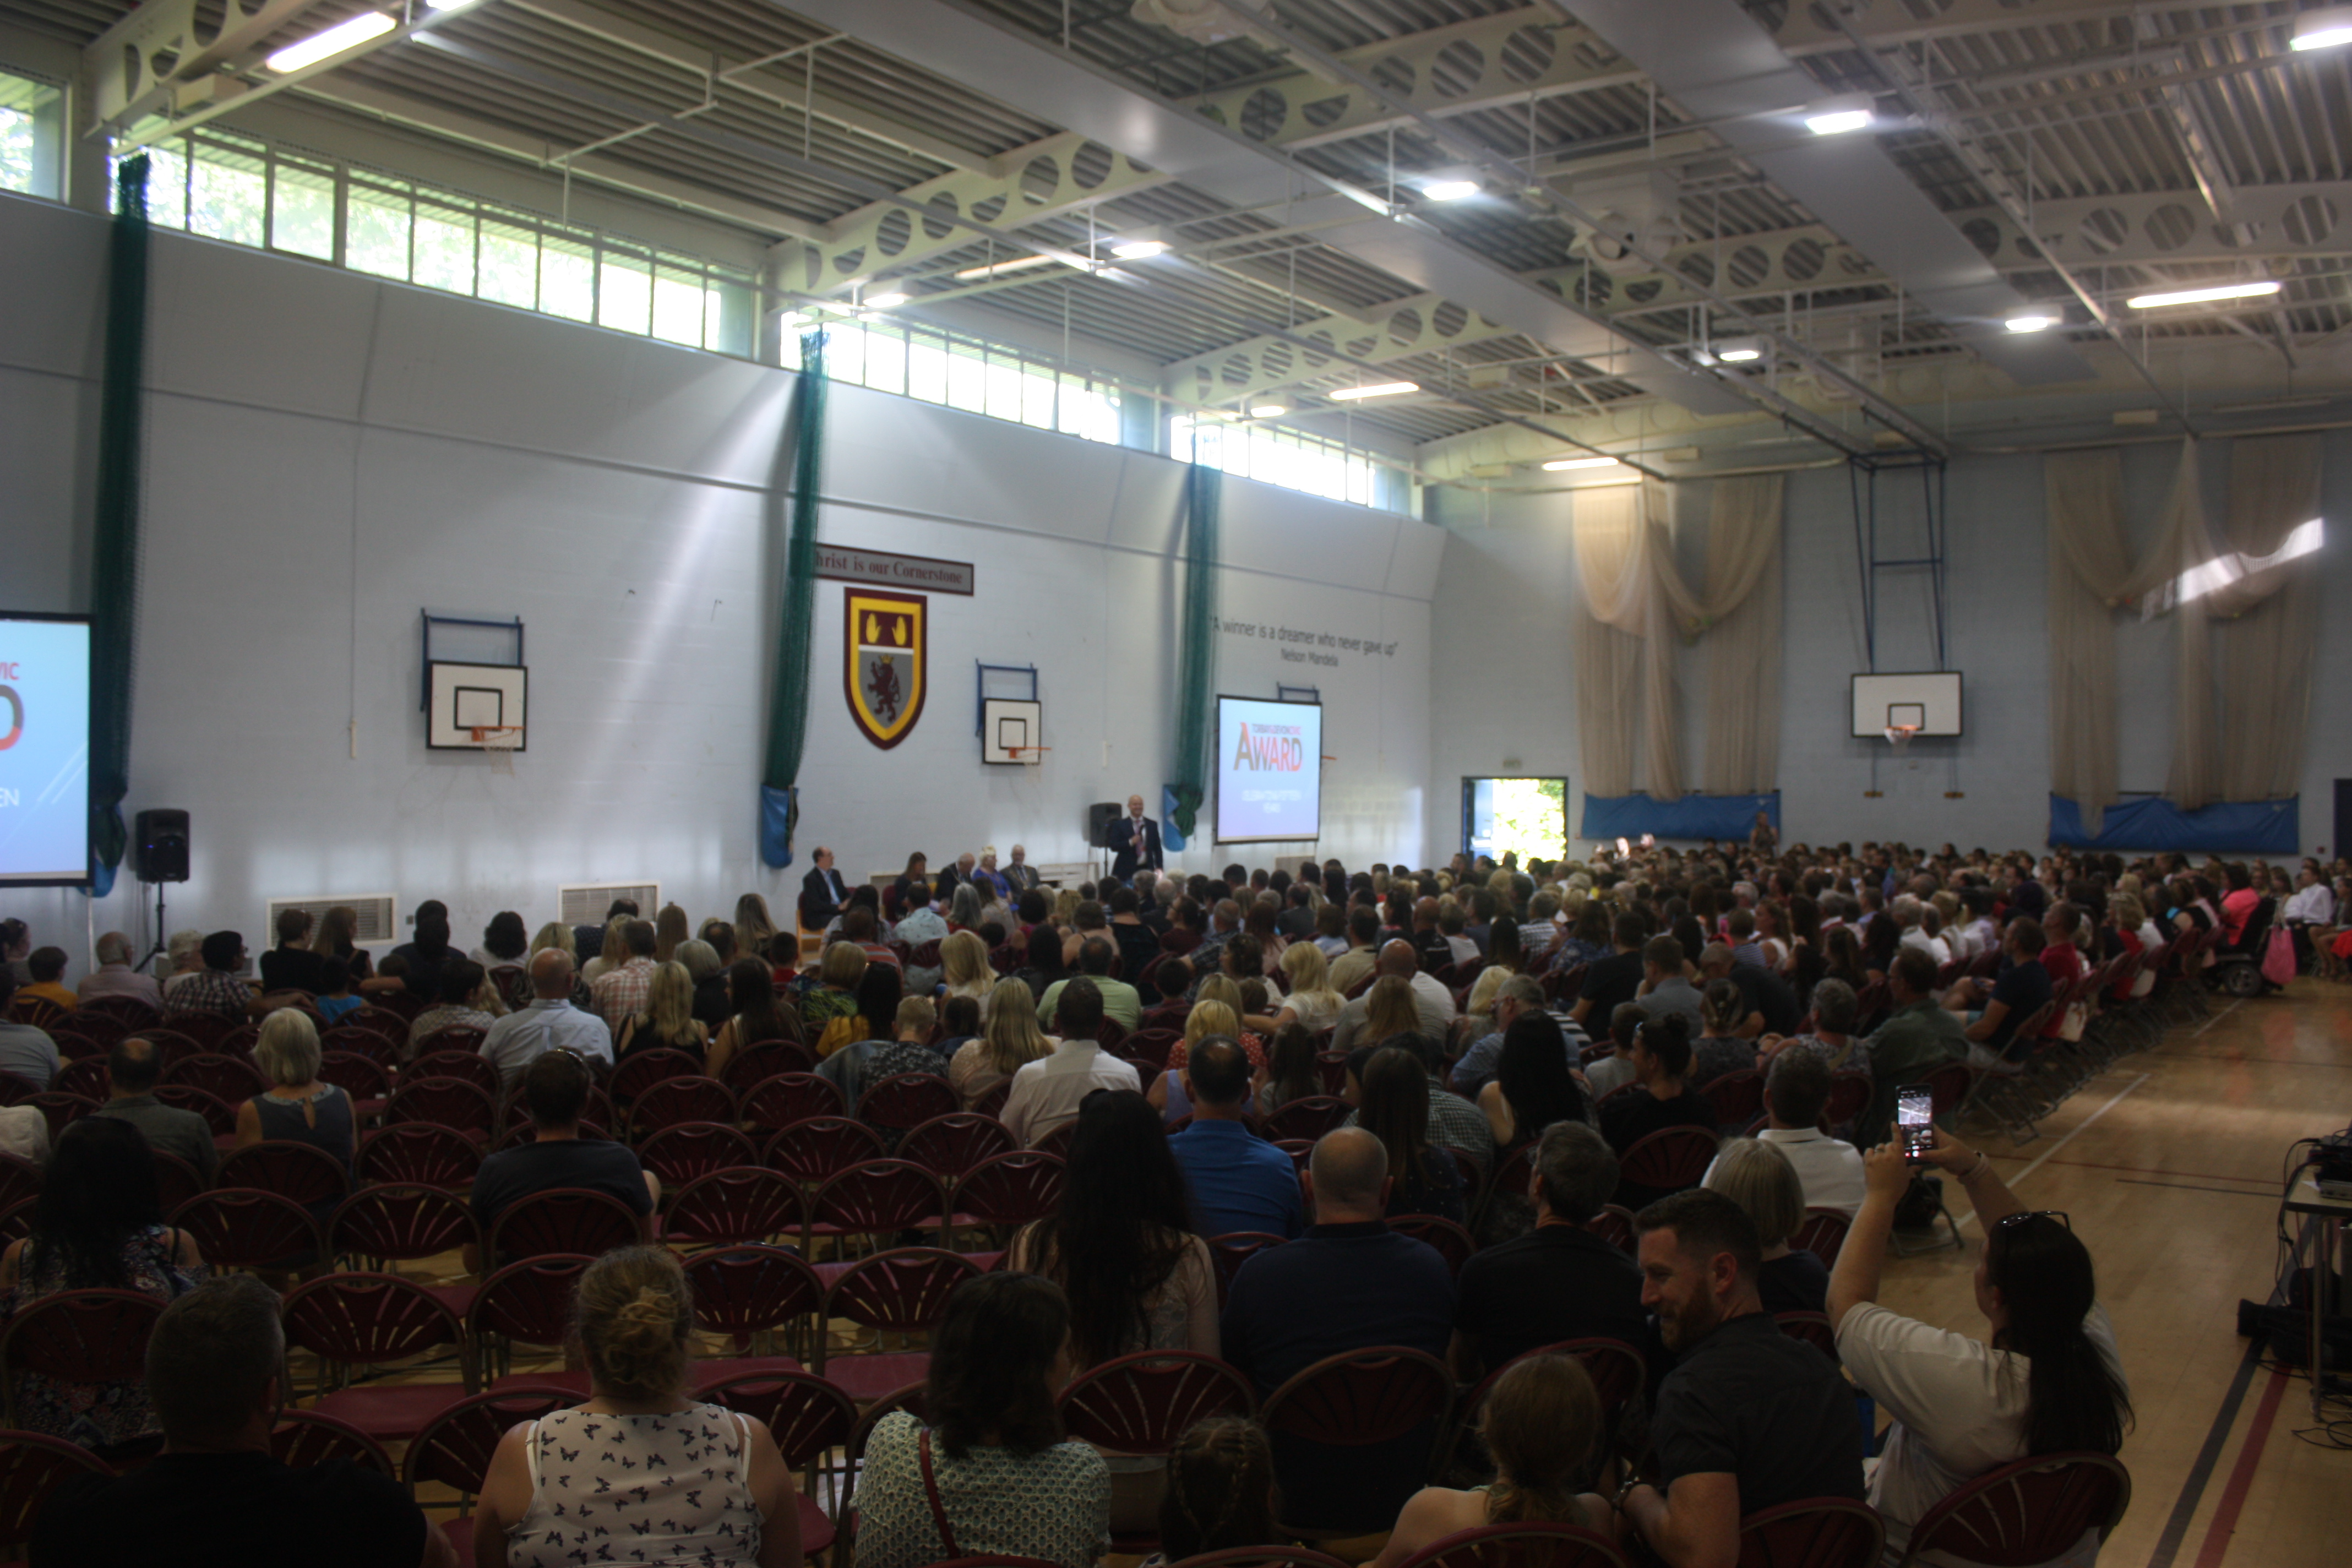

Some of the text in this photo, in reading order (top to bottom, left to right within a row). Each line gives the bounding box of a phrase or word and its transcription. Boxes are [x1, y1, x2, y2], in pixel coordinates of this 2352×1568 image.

[814, 551, 962, 585] hrist is our Cornerstone
[1223, 618, 1256, 636] winner
[1259, 622, 1266, 638] is
[1268, 626, 1275, 639] a
[1277, 625, 1315, 645] dreamer
[1317, 631, 1335, 647] who
[1338, 636, 1361, 651] never
[1363, 640, 1382, 656] gave
[1281, 647, 1339, 667] Nelson Mandela
[1233, 722, 1303, 771] AWARD
